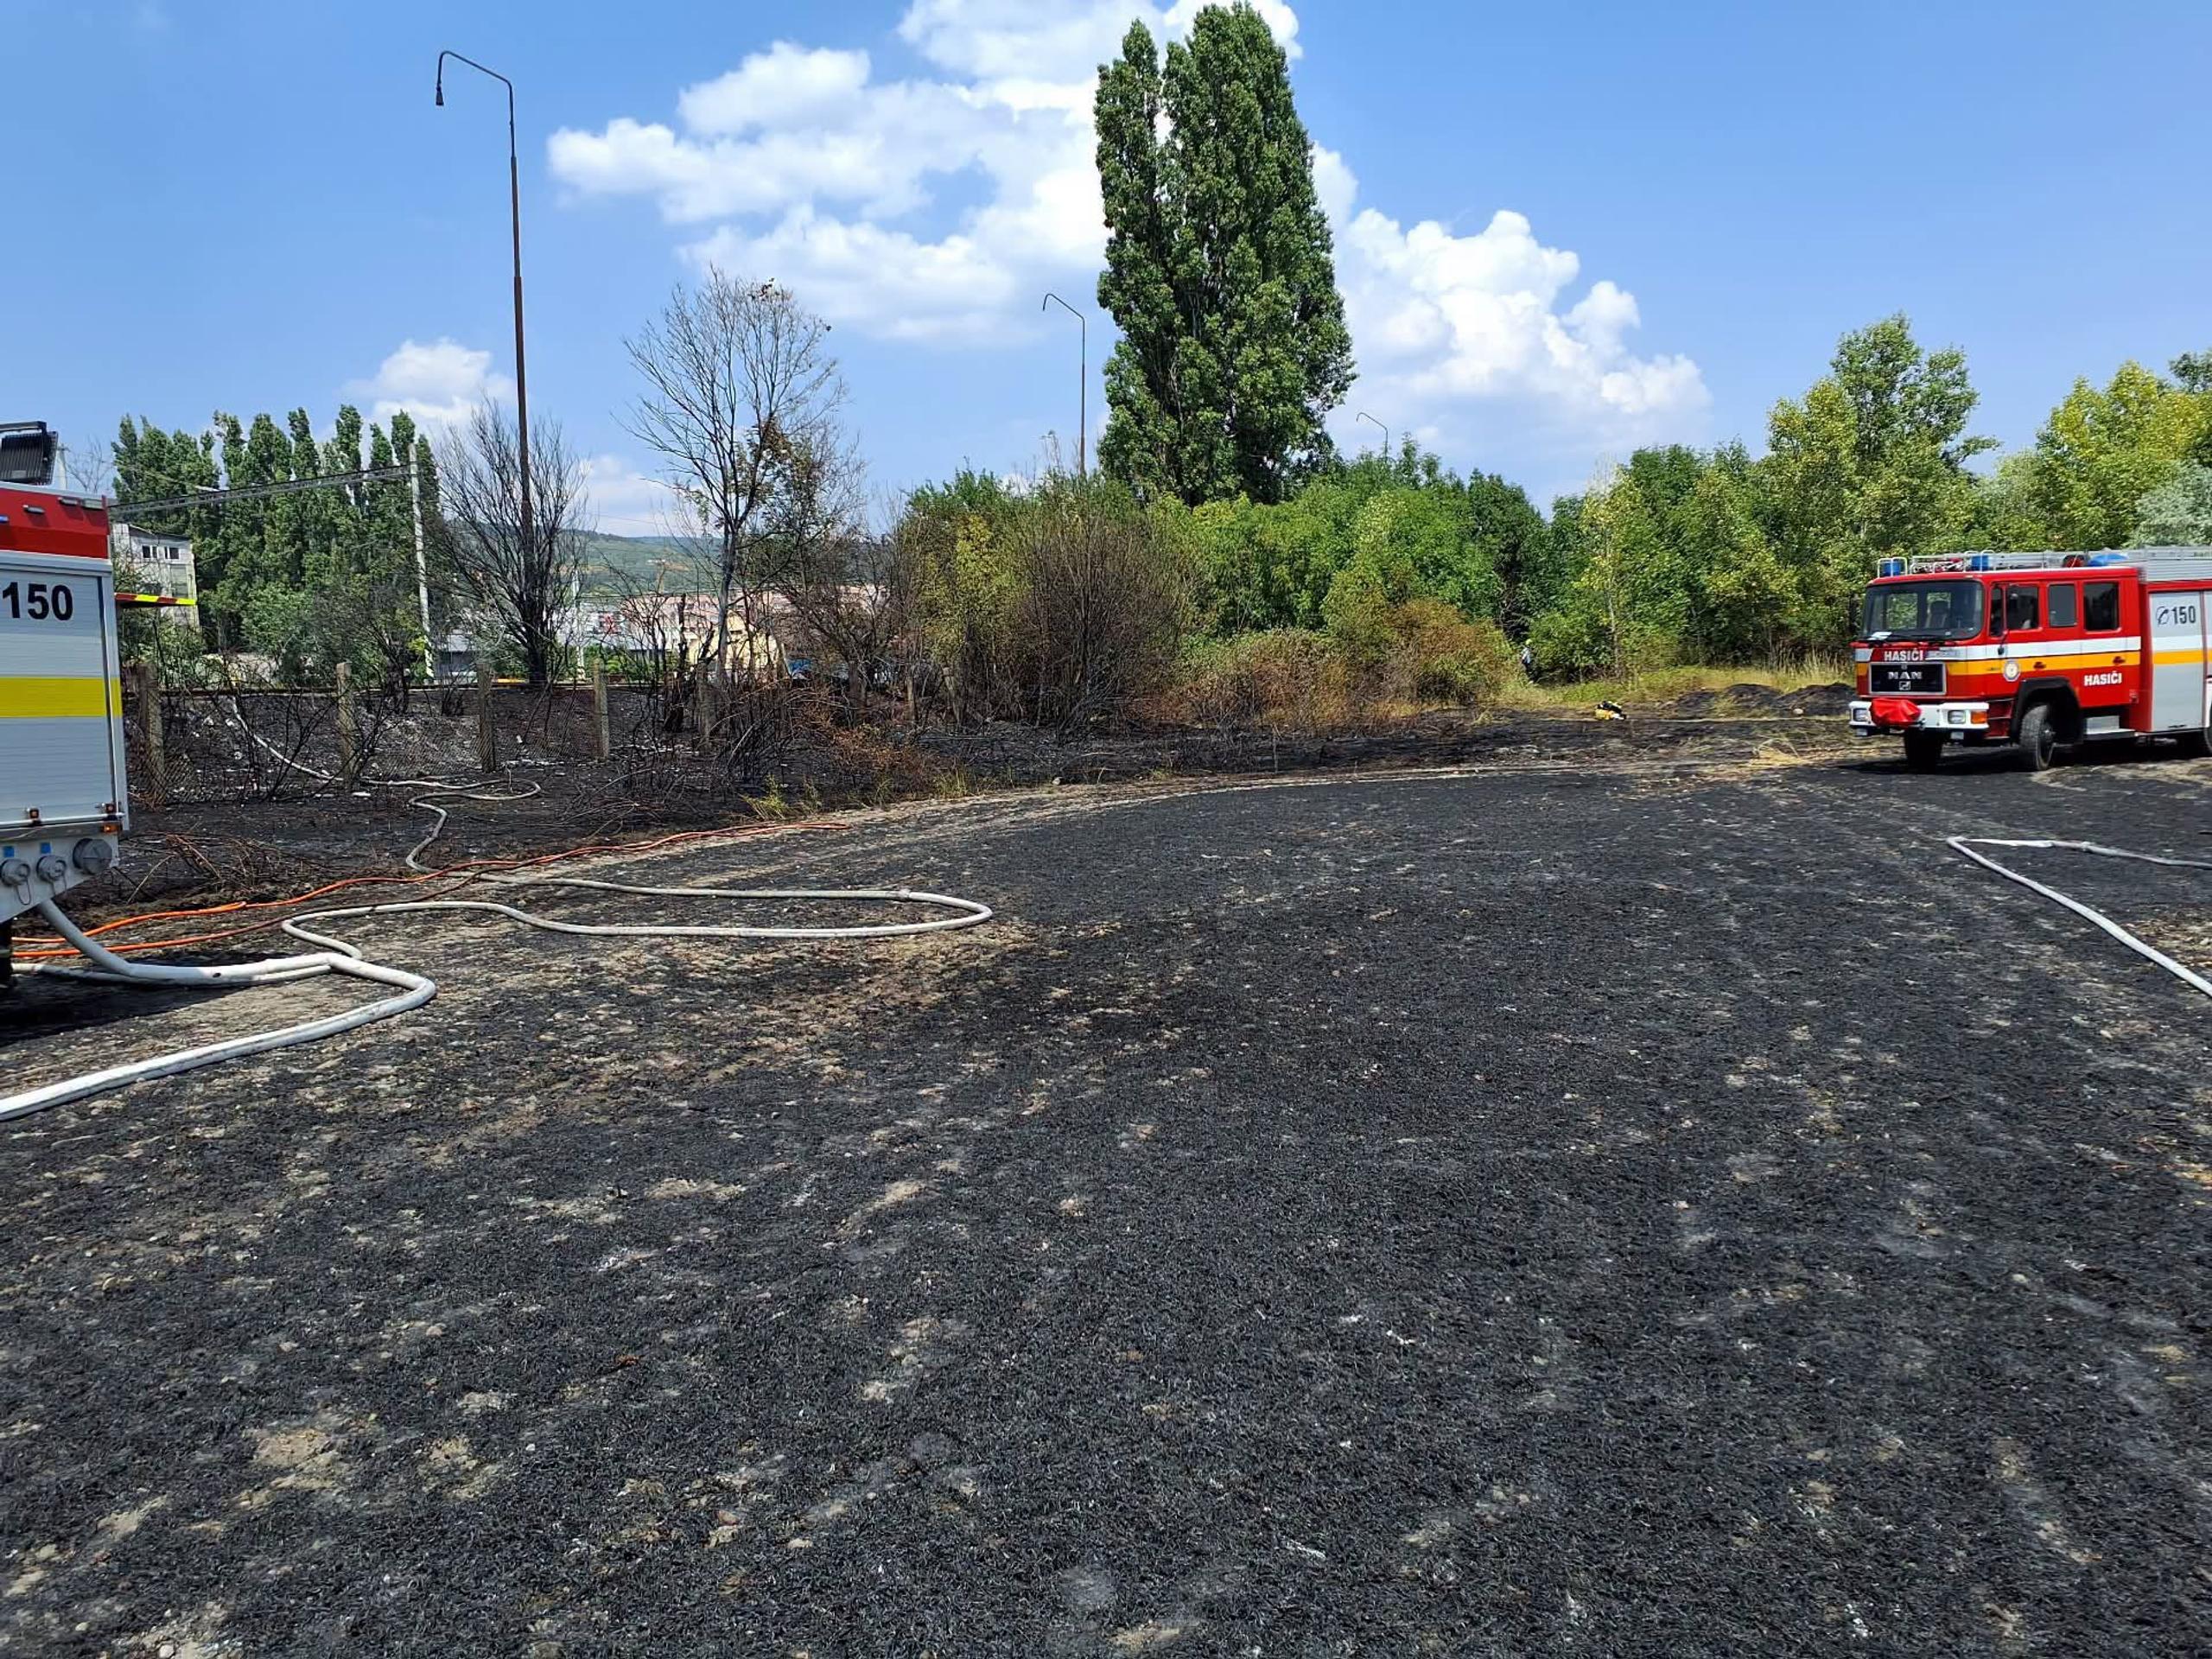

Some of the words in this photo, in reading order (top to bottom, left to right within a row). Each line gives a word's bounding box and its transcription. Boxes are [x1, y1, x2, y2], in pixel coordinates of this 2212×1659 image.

[3, 582, 73, 621] 150
[2171, 605, 2196, 625] 150
[1884, 647, 1924, 662] HASIČI
[1887, 671, 1923, 680] MAN
[2083, 670, 2123, 687] HASIČI
